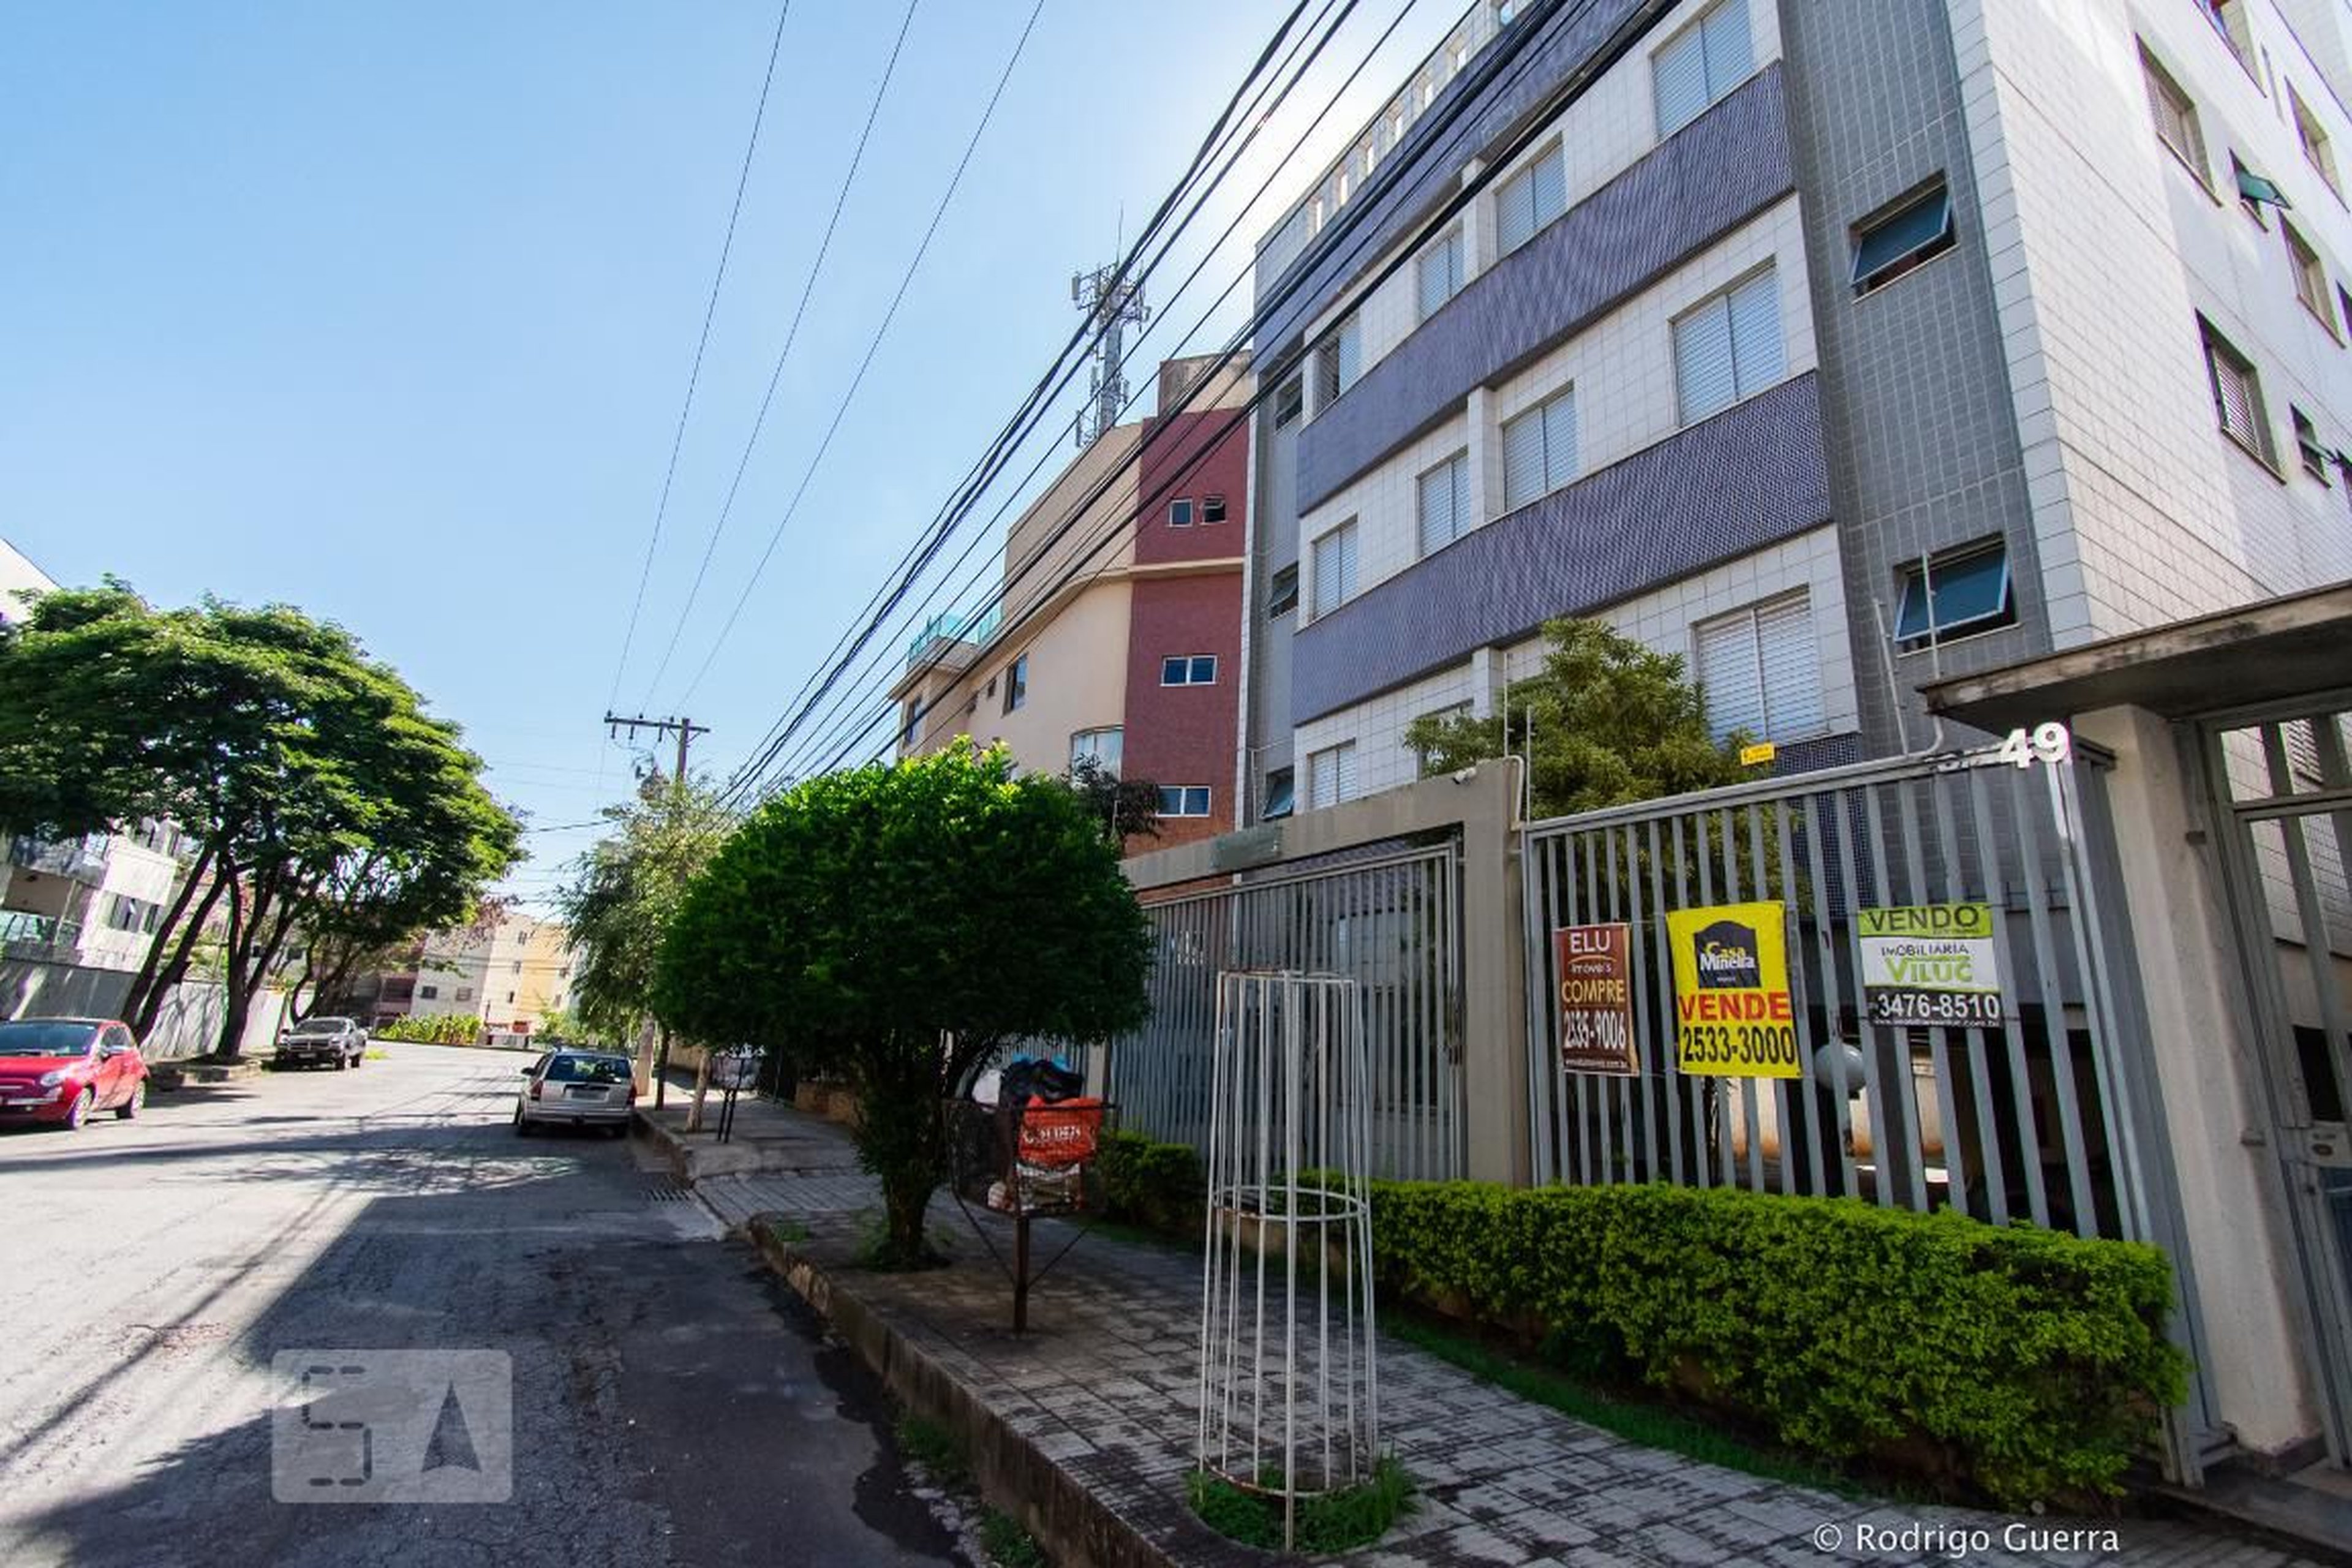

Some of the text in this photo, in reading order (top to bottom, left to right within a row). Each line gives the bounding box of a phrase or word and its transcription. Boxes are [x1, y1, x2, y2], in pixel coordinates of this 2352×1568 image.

[2000, 722, 2070, 769] 49
[1868, 905, 1979, 932] VENDO
[1570, 930, 1611, 953] ELU
[1705, 941, 1746, 959] Casa
[1562, 979, 1626, 1003] COMPRE
[1679, 992, 1792, 1022] VENDE
[1878, 993, 2000, 1019] 3476-8510
[1682, 1025, 1795, 1065] 2533-3000
